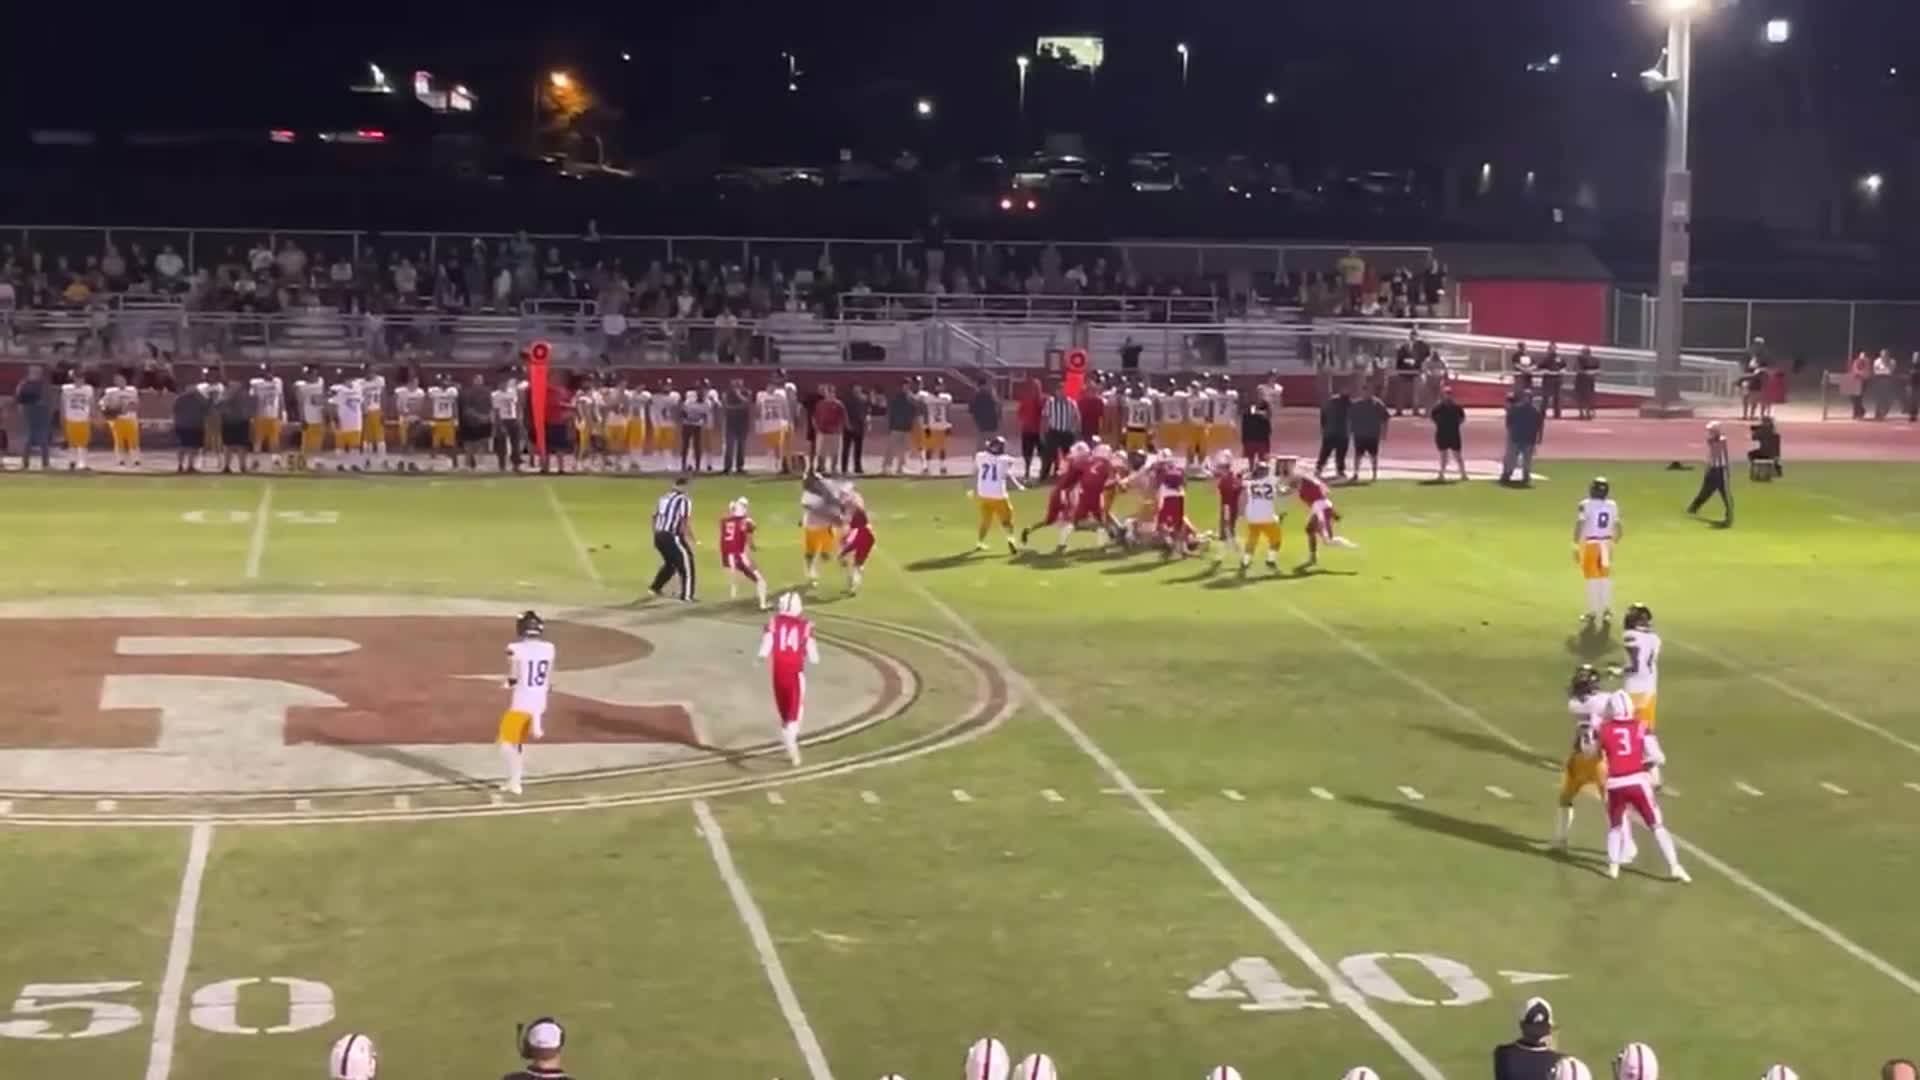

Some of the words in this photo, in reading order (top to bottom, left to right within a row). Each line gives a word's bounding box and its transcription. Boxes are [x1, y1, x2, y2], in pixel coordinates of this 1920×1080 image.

[981, 463, 998, 481] 71
[779, 627, 799, 652] 14
[528, 660, 548, 686] 18
[1613, 727, 1632, 756] 3
[1187, 952, 1493, 1010] 40
[0, 977, 335, 1039] 50
